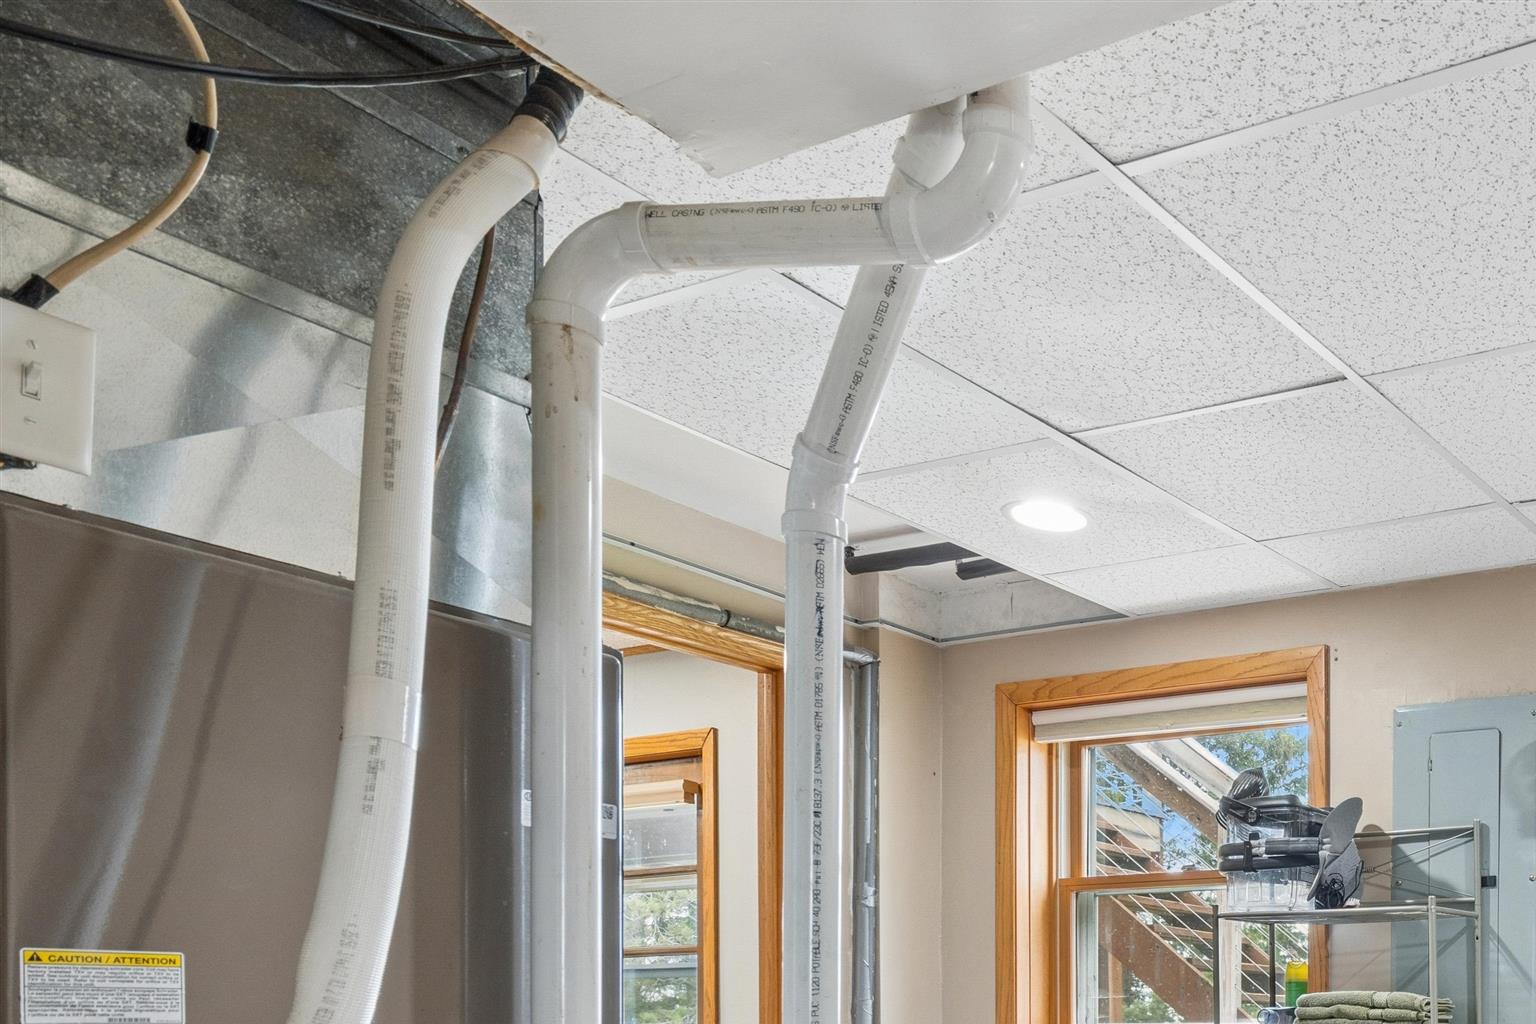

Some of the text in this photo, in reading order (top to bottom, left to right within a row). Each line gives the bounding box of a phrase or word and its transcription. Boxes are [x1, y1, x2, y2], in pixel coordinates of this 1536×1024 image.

[671, 207, 705, 218] CASING
[756, 204, 780, 215] ASTM
[843, 392, 856, 415] ASTM
[814, 711, 824, 733] ASTM
[47, 954, 177, 966] CAUTION / ATTENTION
